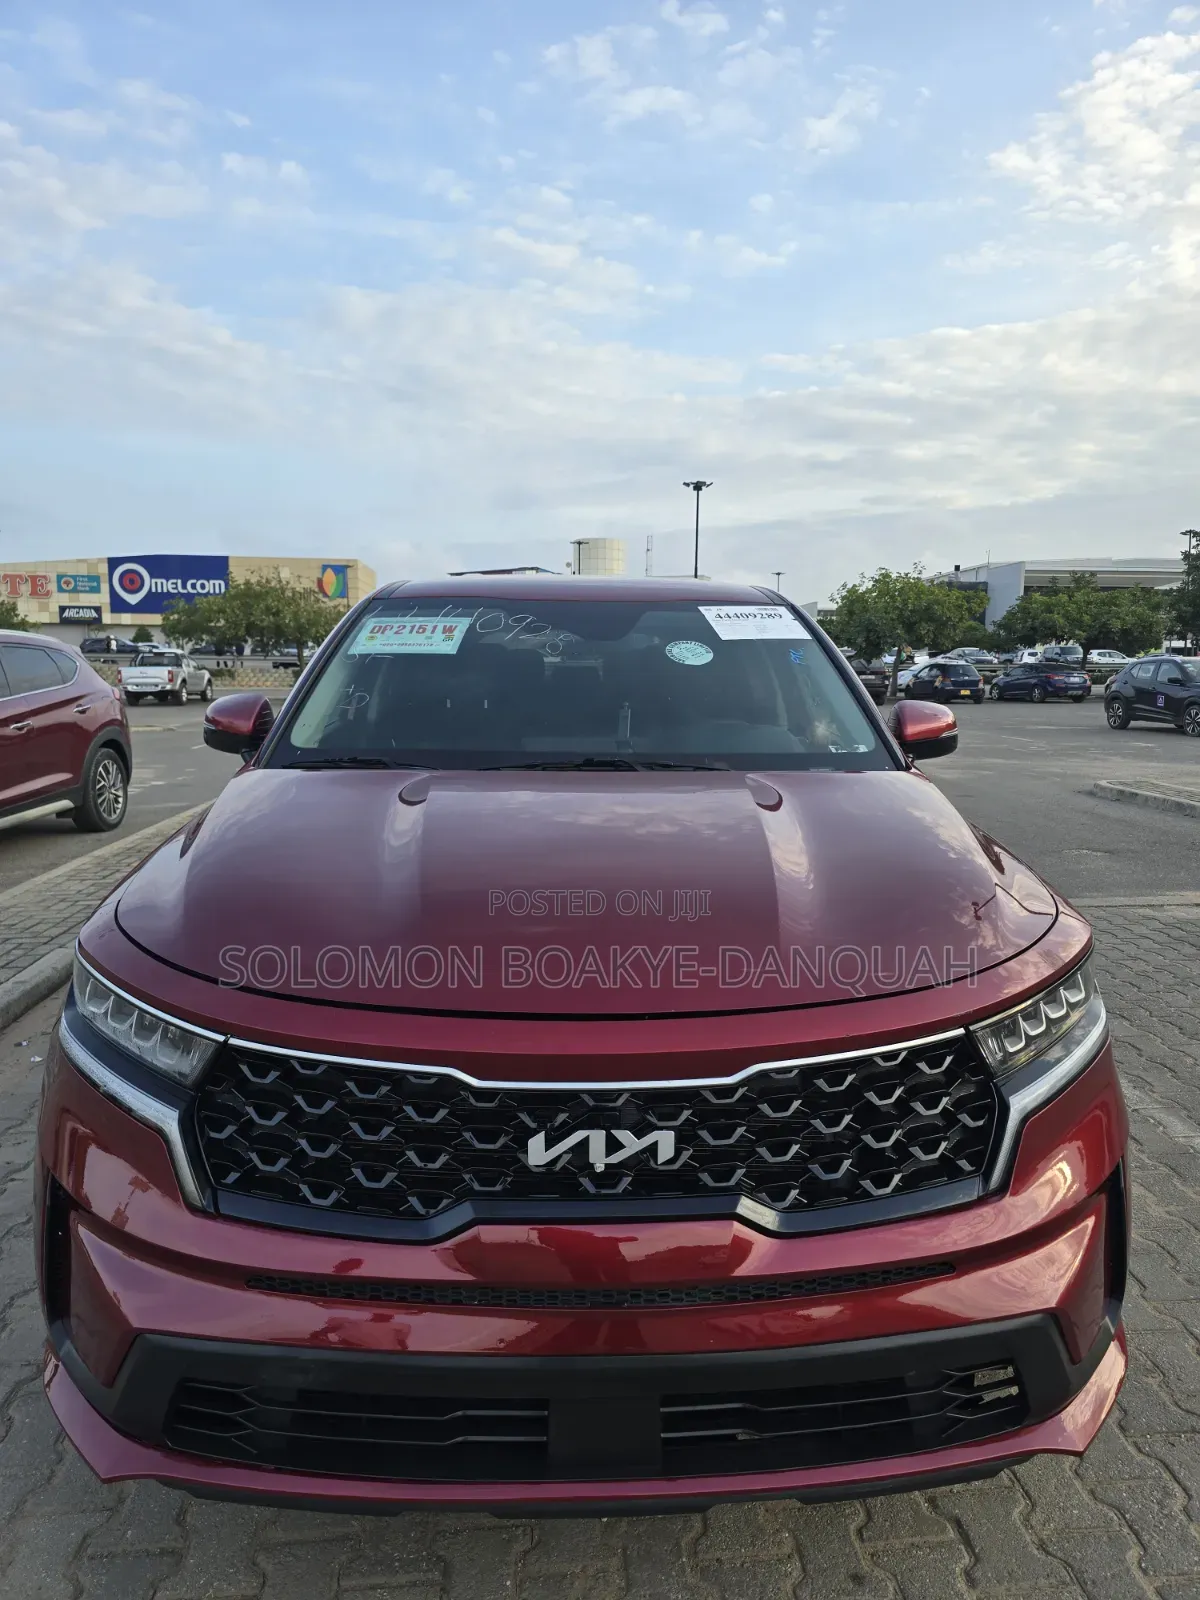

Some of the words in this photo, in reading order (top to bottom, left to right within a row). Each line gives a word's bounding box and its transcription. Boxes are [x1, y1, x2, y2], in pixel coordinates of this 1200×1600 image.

[151, 578, 226, 594] MELCOM
[62, 608, 99, 618] ARCADIA
[714, 612, 783, 620] 44409289
